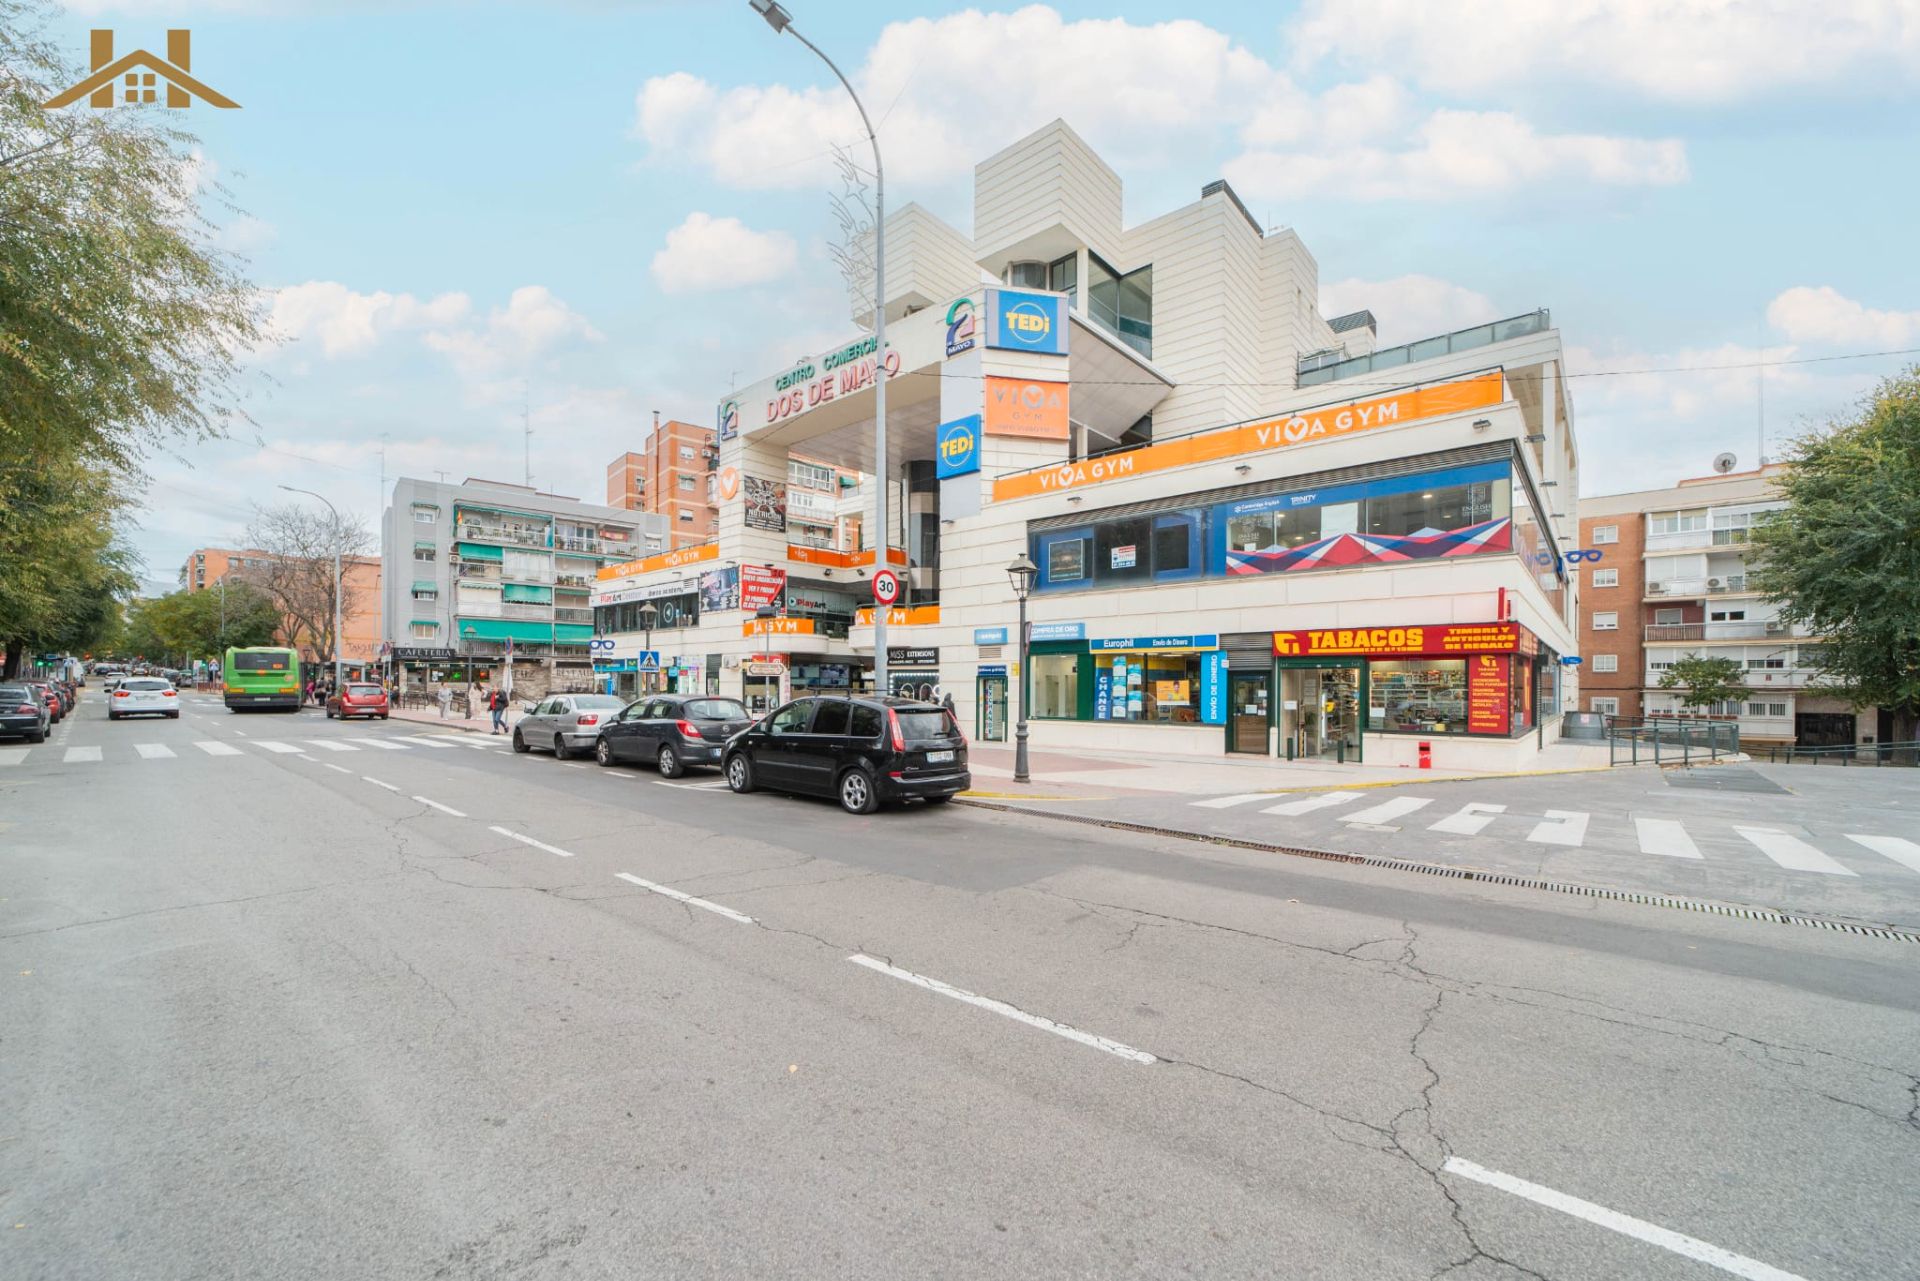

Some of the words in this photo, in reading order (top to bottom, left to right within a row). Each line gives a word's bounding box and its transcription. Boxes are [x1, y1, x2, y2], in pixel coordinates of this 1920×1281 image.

[1005, 311, 1050, 333] TEDi
[775, 364, 815, 391] CENTRO
[766, 388, 804, 423] DOS
[807, 374, 835, 407] DE
[1335, 401, 1399, 430] GYM
[940, 434, 974, 459] TEDi
[1092, 455, 1134, 483] GYM
[878, 580, 894, 593] 30
[765, 621, 798, 632] GYM
[1103, 639, 1134, 648] Europhil
[1308, 628, 1423, 649] TABACOS
[398, 648, 451, 657] CAFETERIA
[906, 650, 936, 658] EXTENSIONS
[1210, 655, 1218, 683] DINERO
[1098, 676, 1108, 719] CHANGE
[1210, 685, 1218, 696] DE
